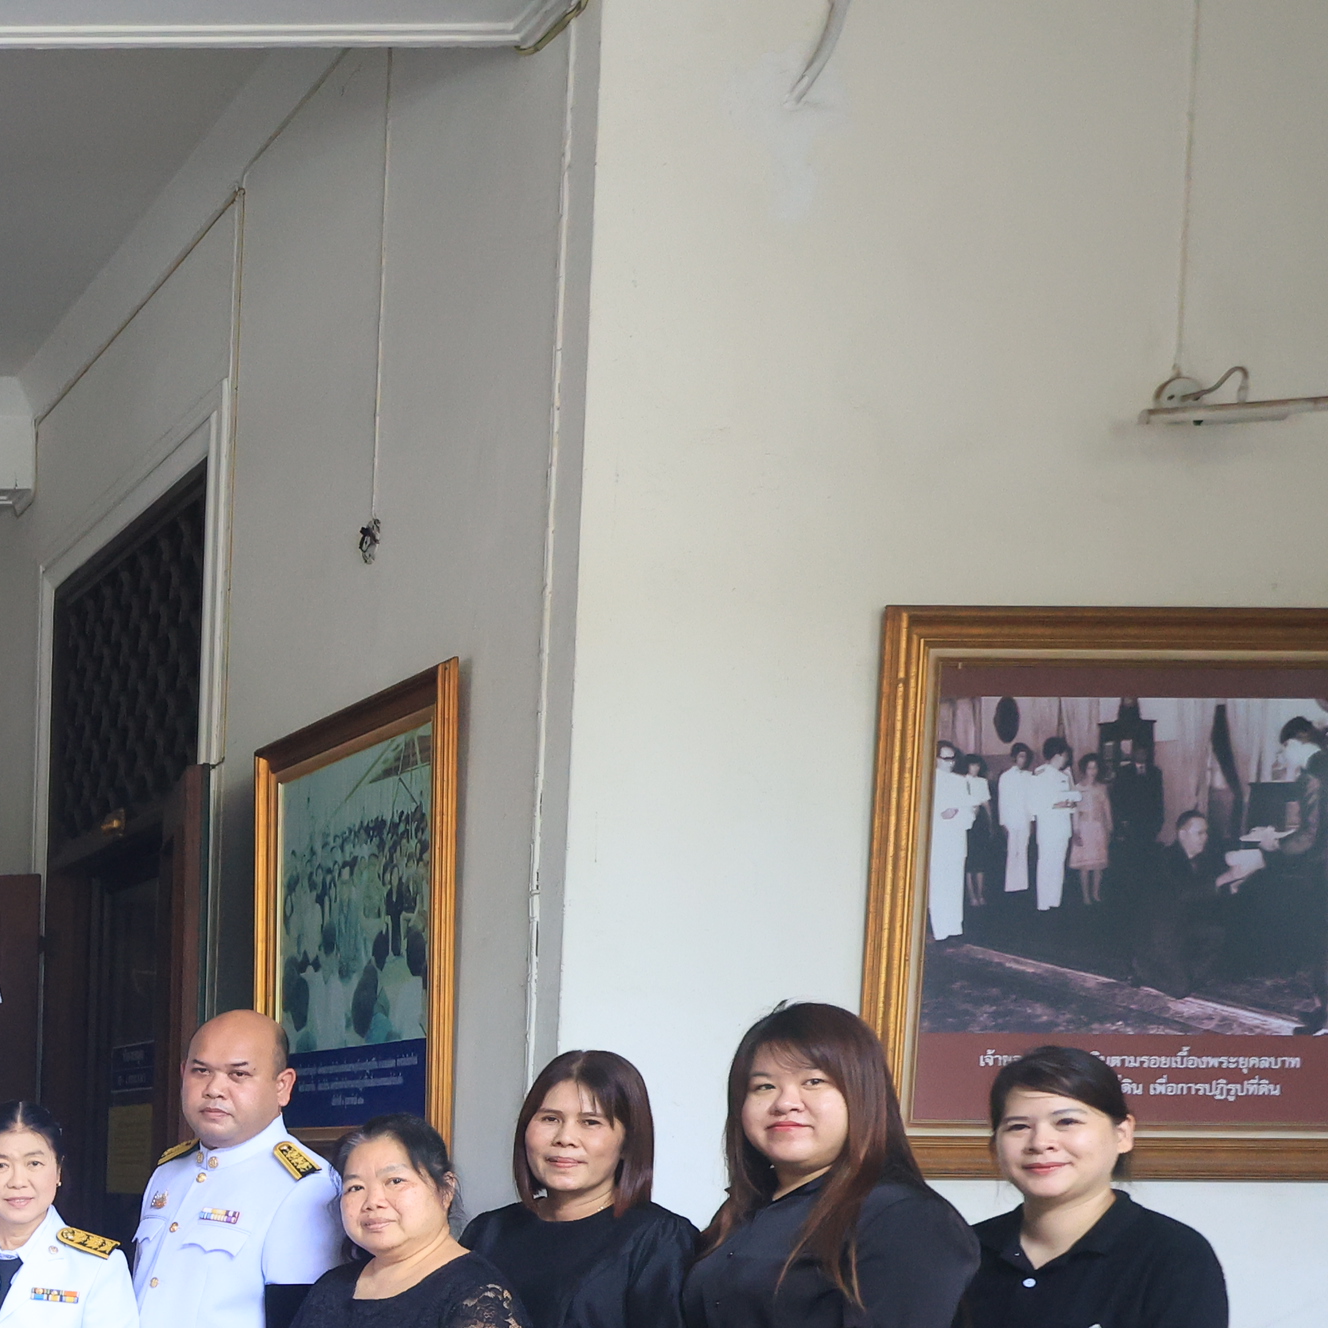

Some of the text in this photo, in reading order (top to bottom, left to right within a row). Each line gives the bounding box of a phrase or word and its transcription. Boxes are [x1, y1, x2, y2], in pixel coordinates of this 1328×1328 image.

[1149, 1075, 1281, 1100] เพื่อการปฏิรูปที่ดิน
